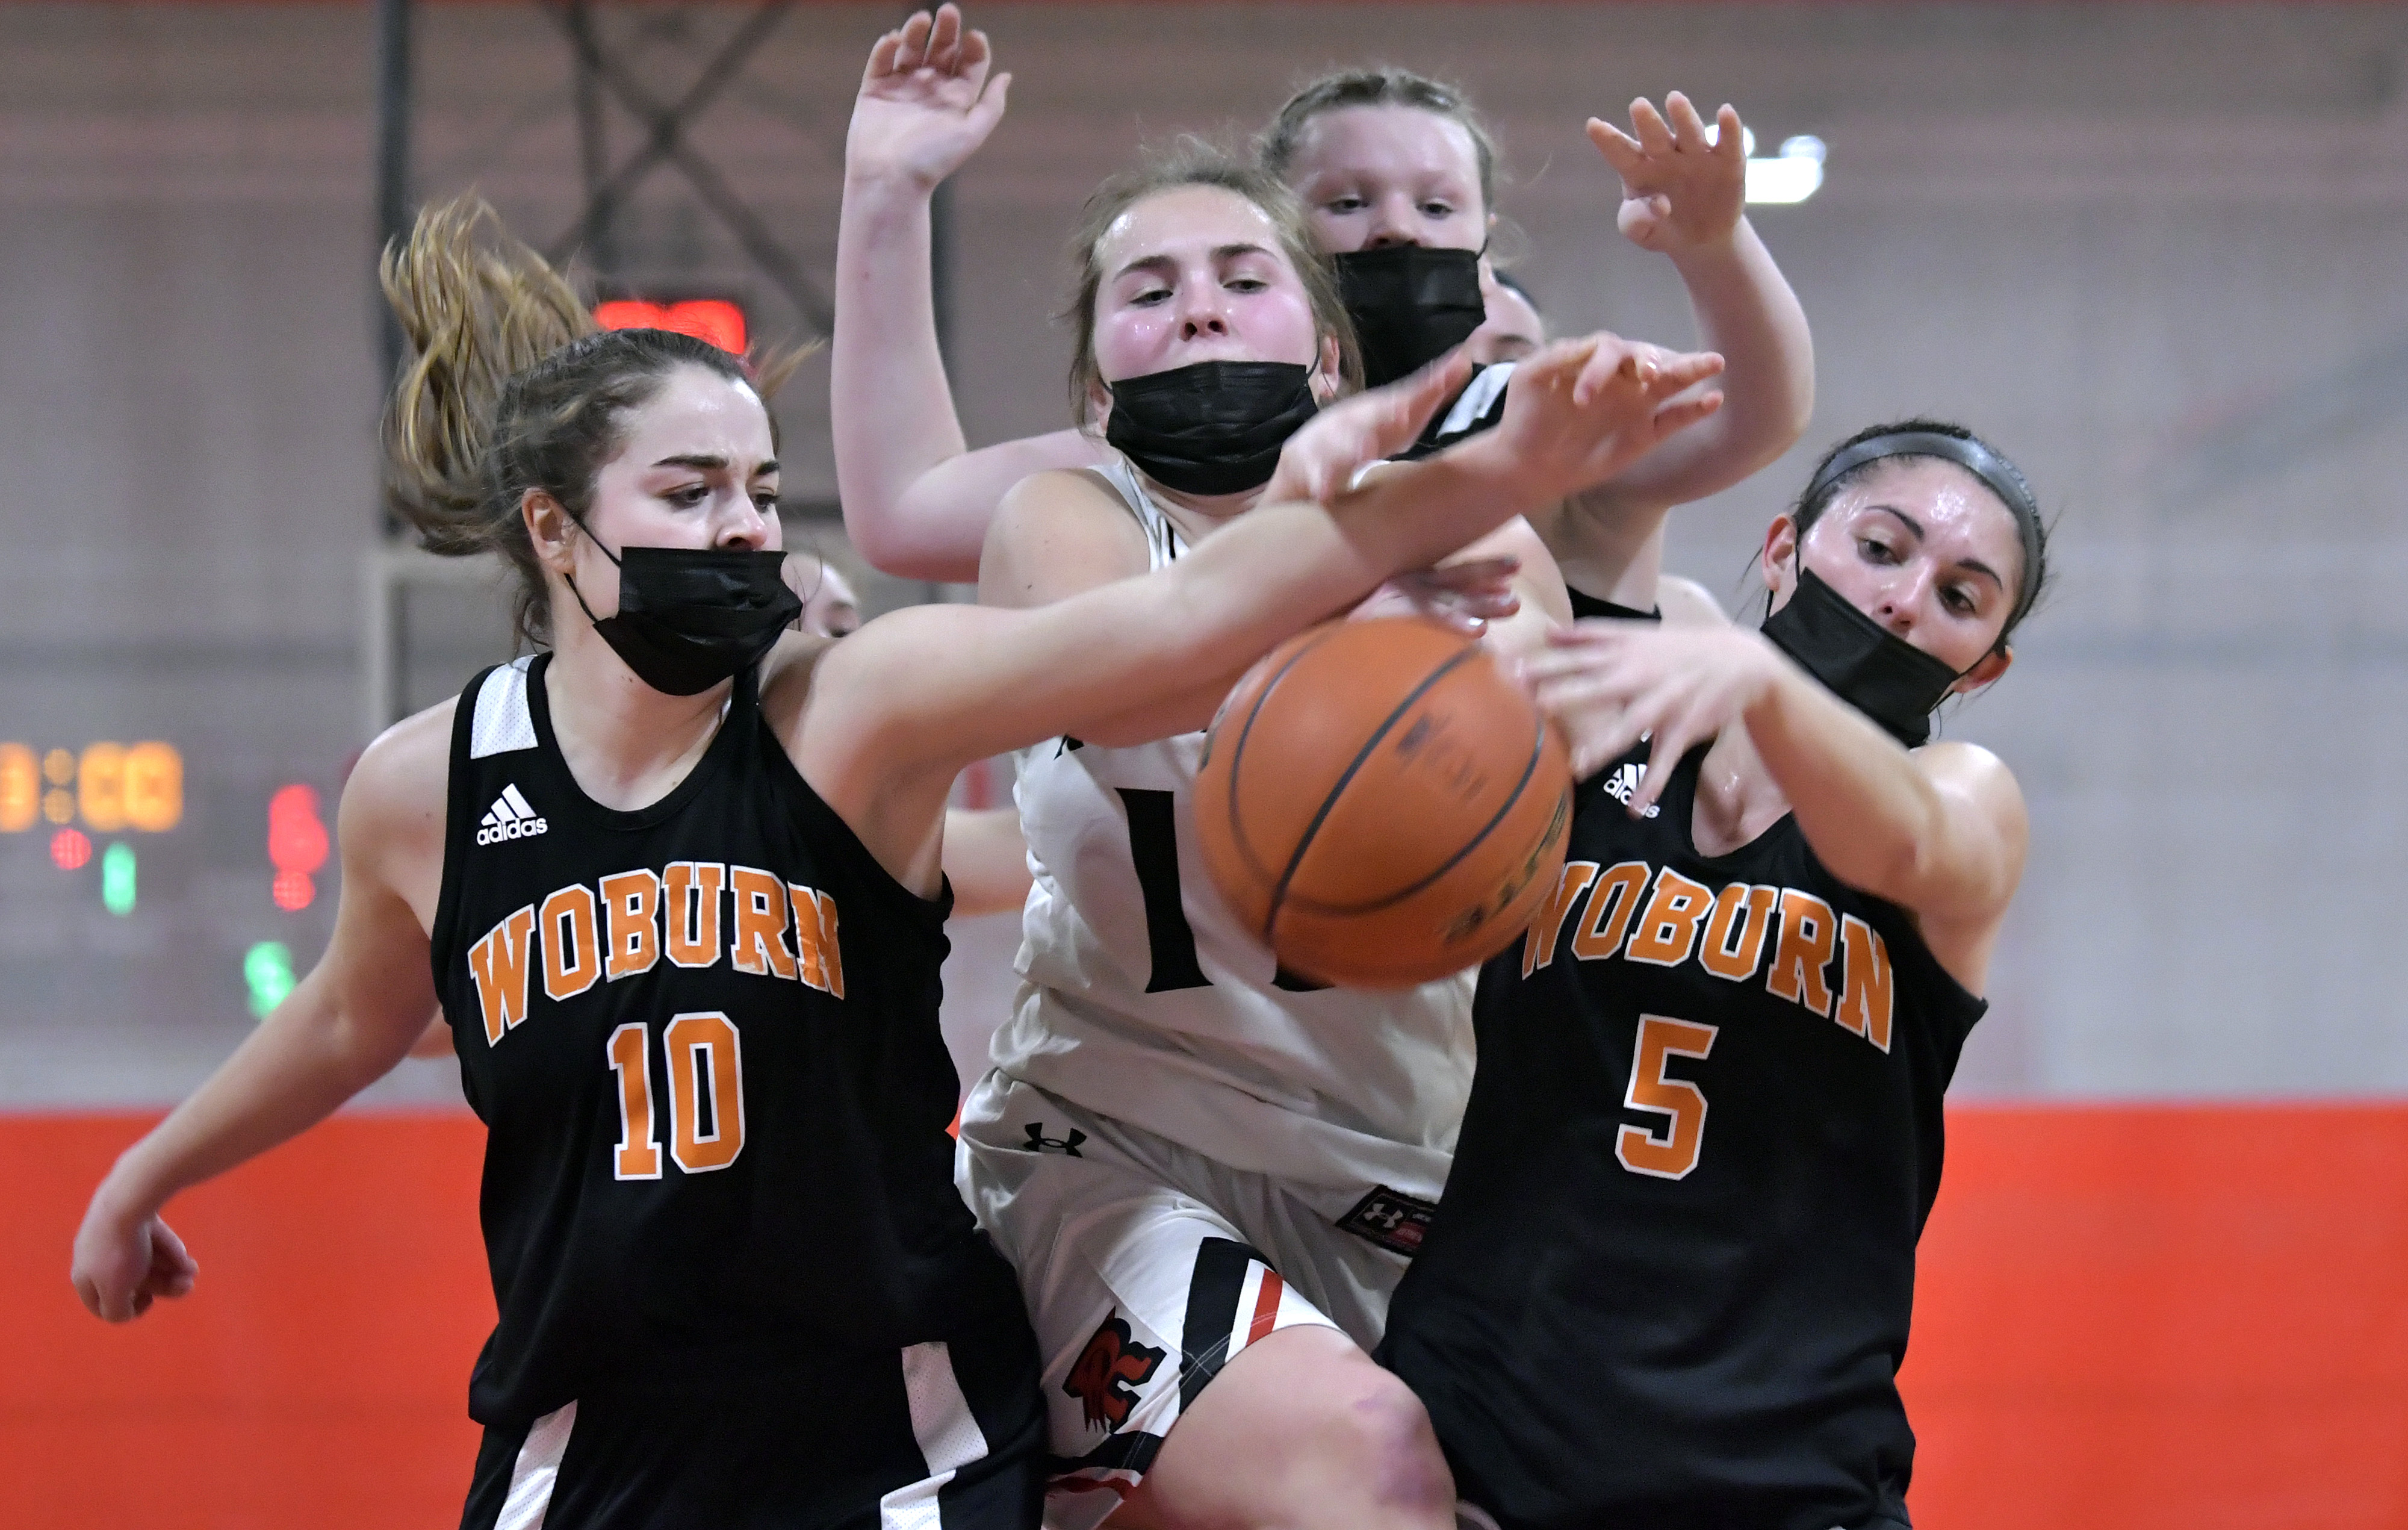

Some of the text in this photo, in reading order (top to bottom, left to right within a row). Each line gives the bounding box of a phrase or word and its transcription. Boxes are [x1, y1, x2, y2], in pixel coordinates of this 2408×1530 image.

[477, 818, 548, 845] adidas
[468, 861, 844, 1048] WOBURN
[1522, 861, 1894, 1054] WOBURN
[607, 1011, 745, 1180] 10
[1615, 1013, 1719, 1181] 5
